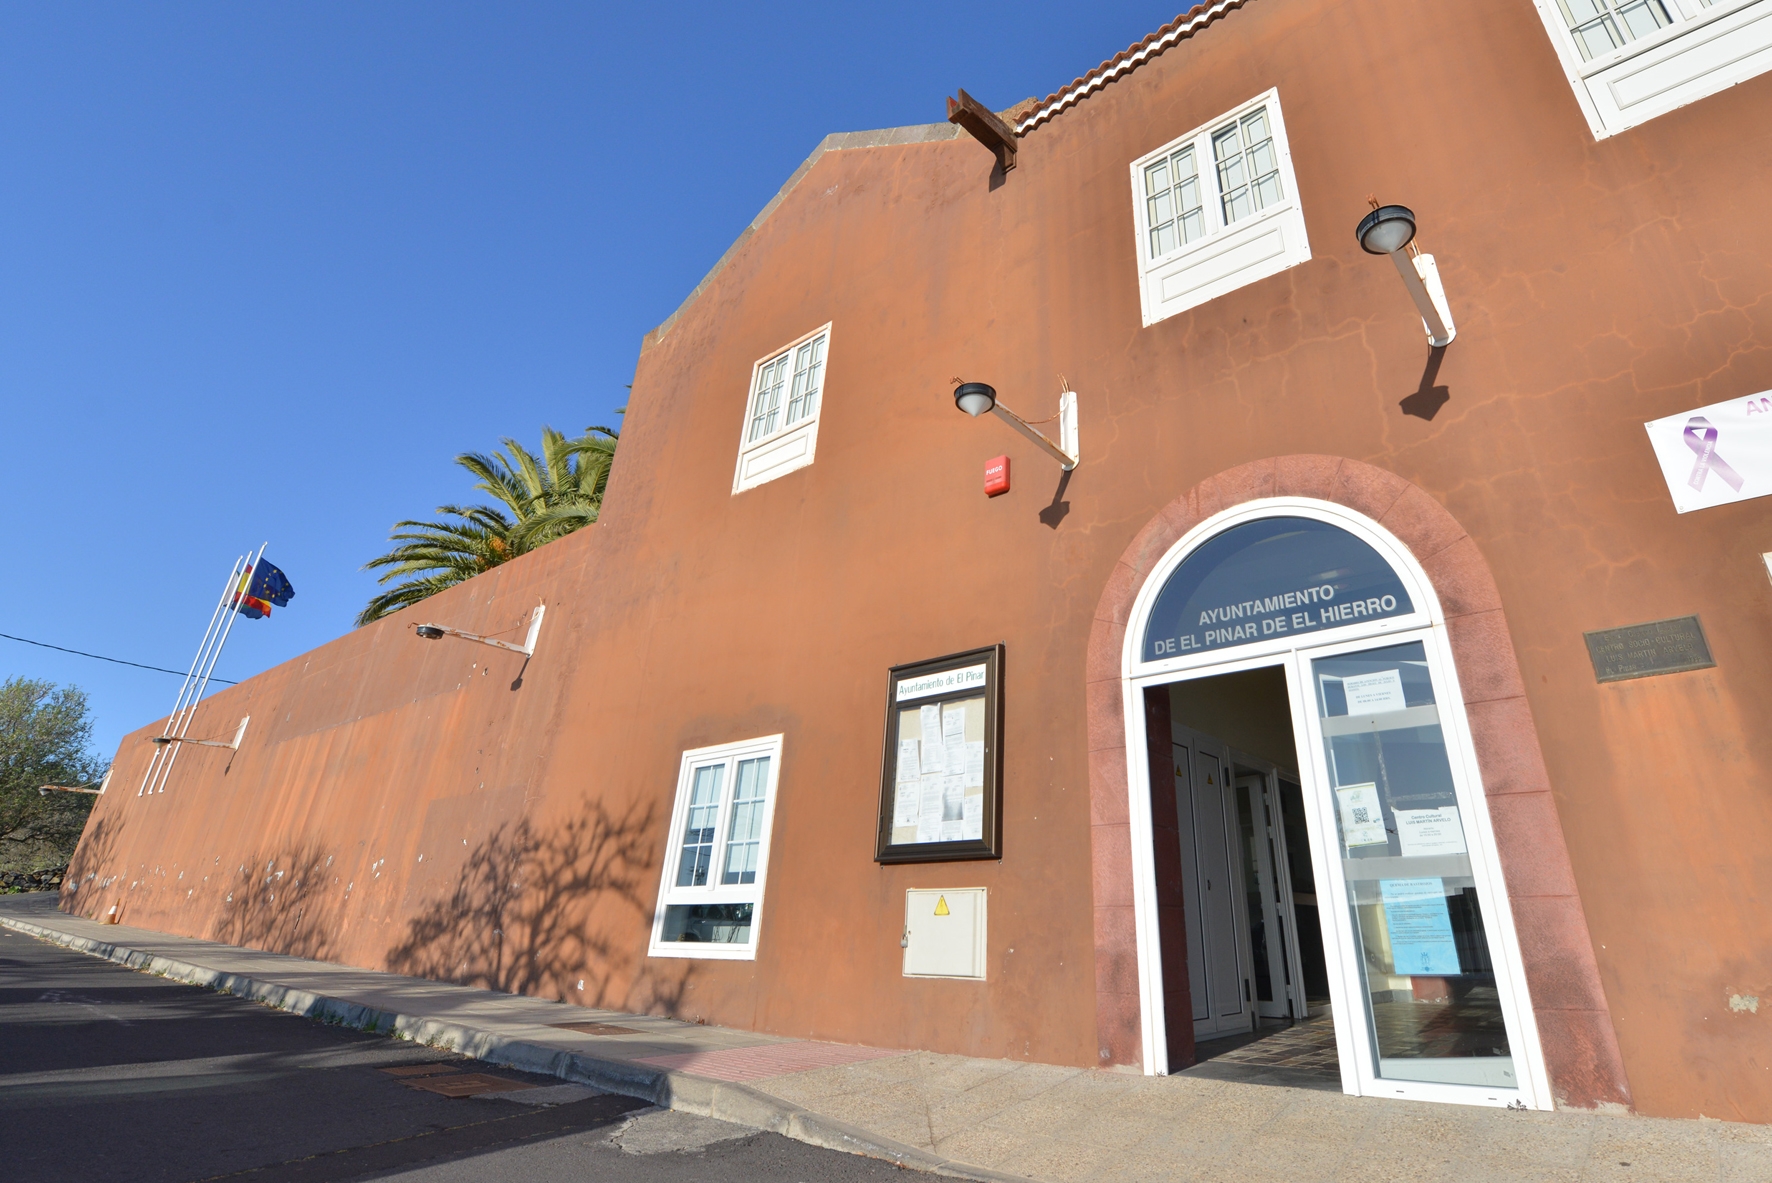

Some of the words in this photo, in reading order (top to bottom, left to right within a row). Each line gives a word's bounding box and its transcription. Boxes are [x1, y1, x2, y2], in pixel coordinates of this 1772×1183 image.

[986, 465, 1003, 475] FUEGO
[1199, 584, 1334, 626] AYUNTAMIENTO
[1154, 639, 1176, 655] DE
[1180, 634, 1201, 650] EL
[1205, 624, 1258, 646] PINAR
[1262, 617, 1287, 636] DE
[1292, 611, 1316, 629] EL
[1320, 594, 1397, 623] HIERRO
[1606, 653, 1623, 663] LUIS
[899, 679, 943, 696] Ayuntamiento
[946, 675, 955, 685] de
[957, 672, 964, 683] El
[966, 670, 984, 682] Pinar
